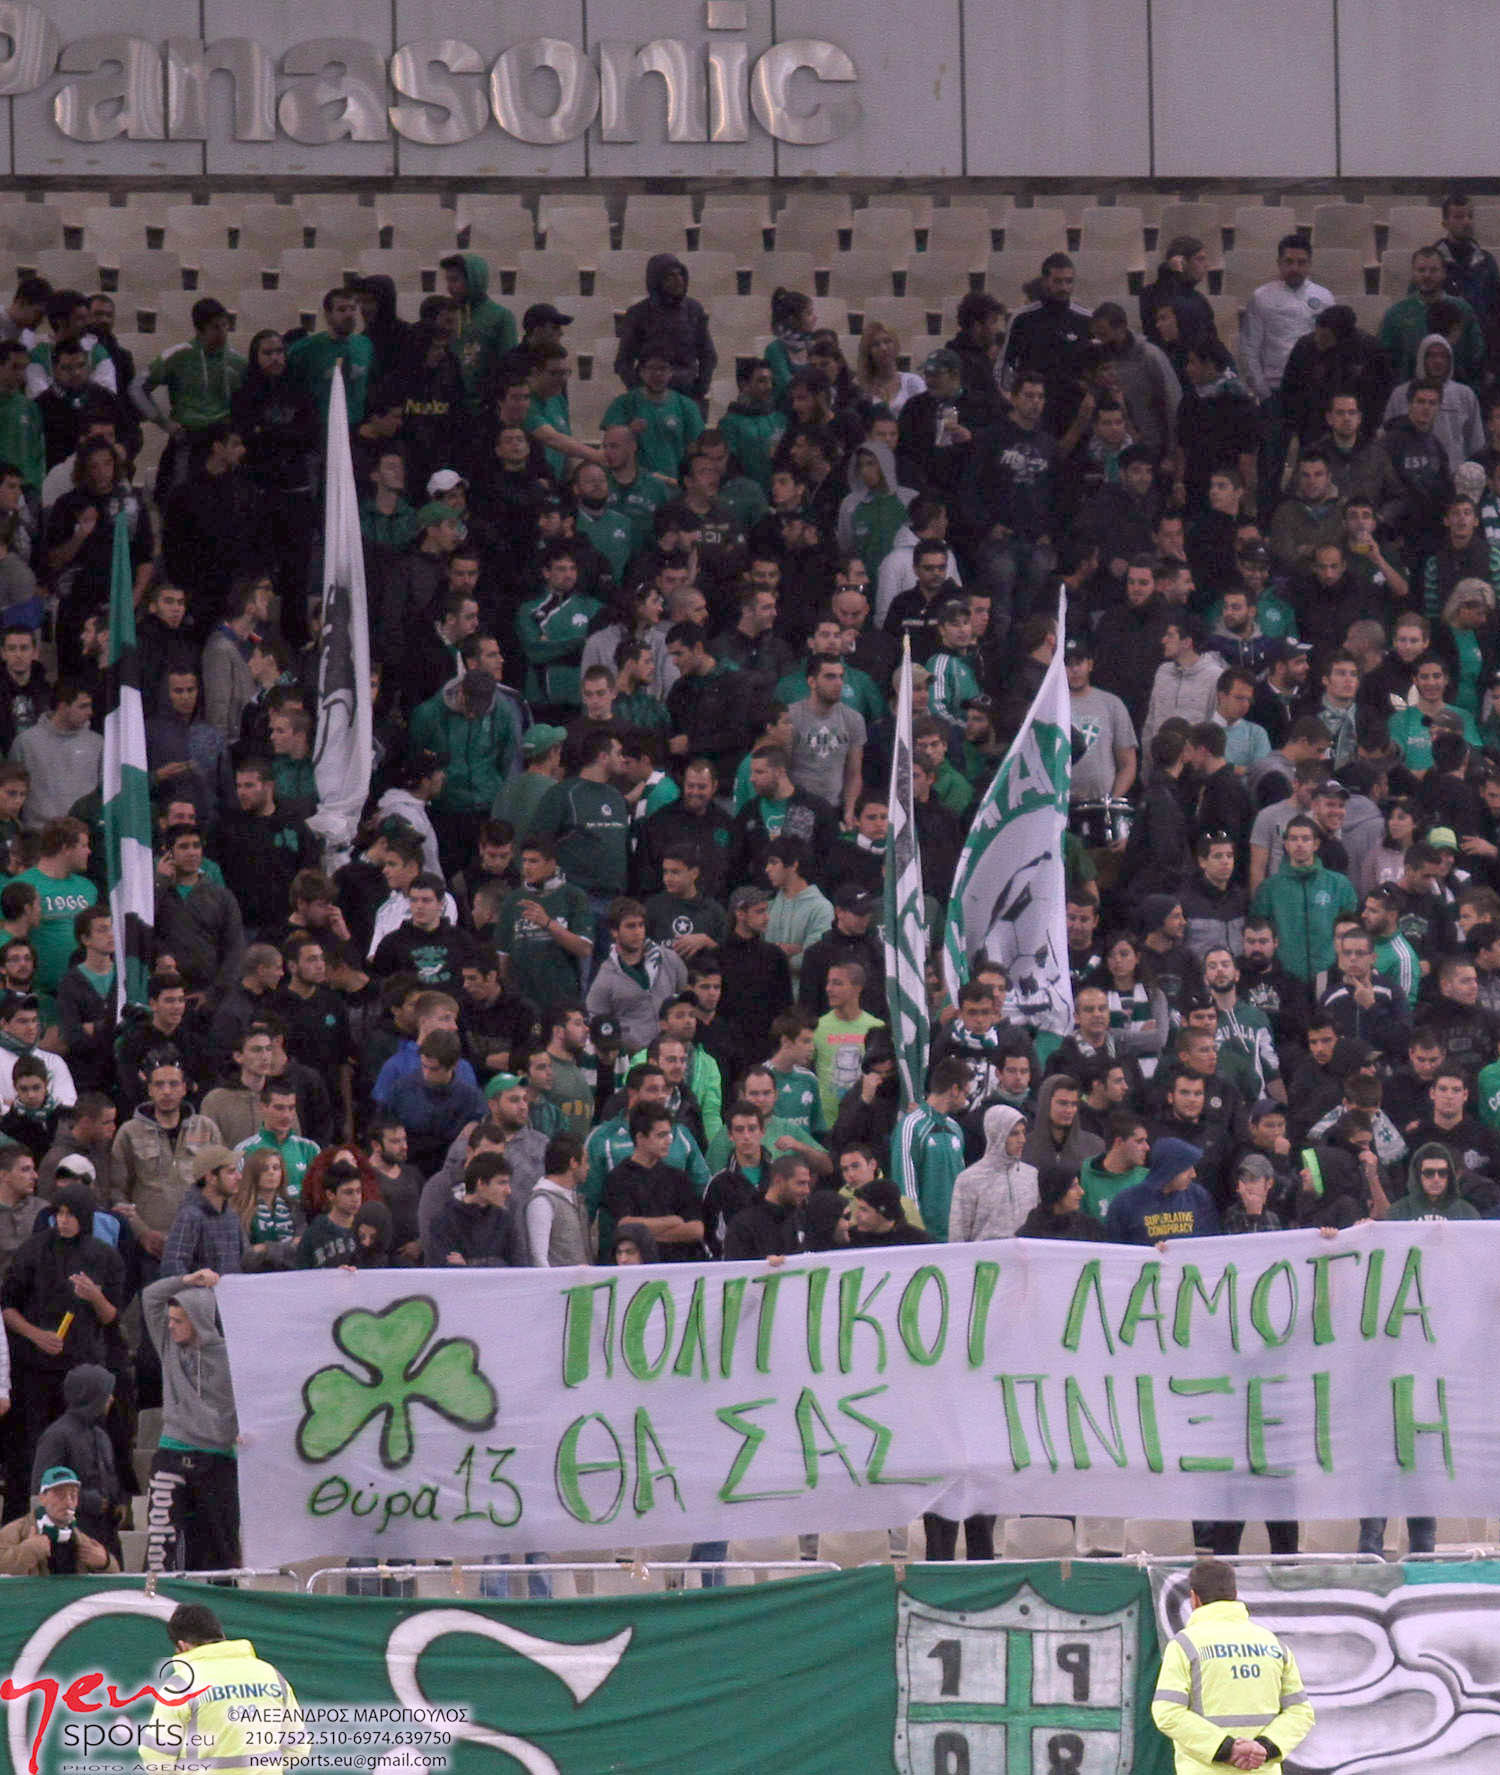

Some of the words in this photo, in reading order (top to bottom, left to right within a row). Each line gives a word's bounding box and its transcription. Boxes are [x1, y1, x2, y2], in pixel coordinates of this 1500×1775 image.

[45, 894, 89, 911] 1966
[560, 1260, 1000, 1389] ΠΟΛΙΤΙΚΟΙ
[1063, 1246, 1437, 1356] ΛΑΜΟΓΙΑ
[554, 1405, 687, 1525] ΘΑ
[713, 1384, 944, 1503] ΣΑΣ
[994, 1371, 1336, 1478] ΠΝΙΞΕΙ
[453, 1444, 524, 1528] 13
[1214, 1643, 1284, 1660] BRINKS
[1231, 1664, 1261, 1680] 160
[212, 1683, 282, 1702] BRINKS
